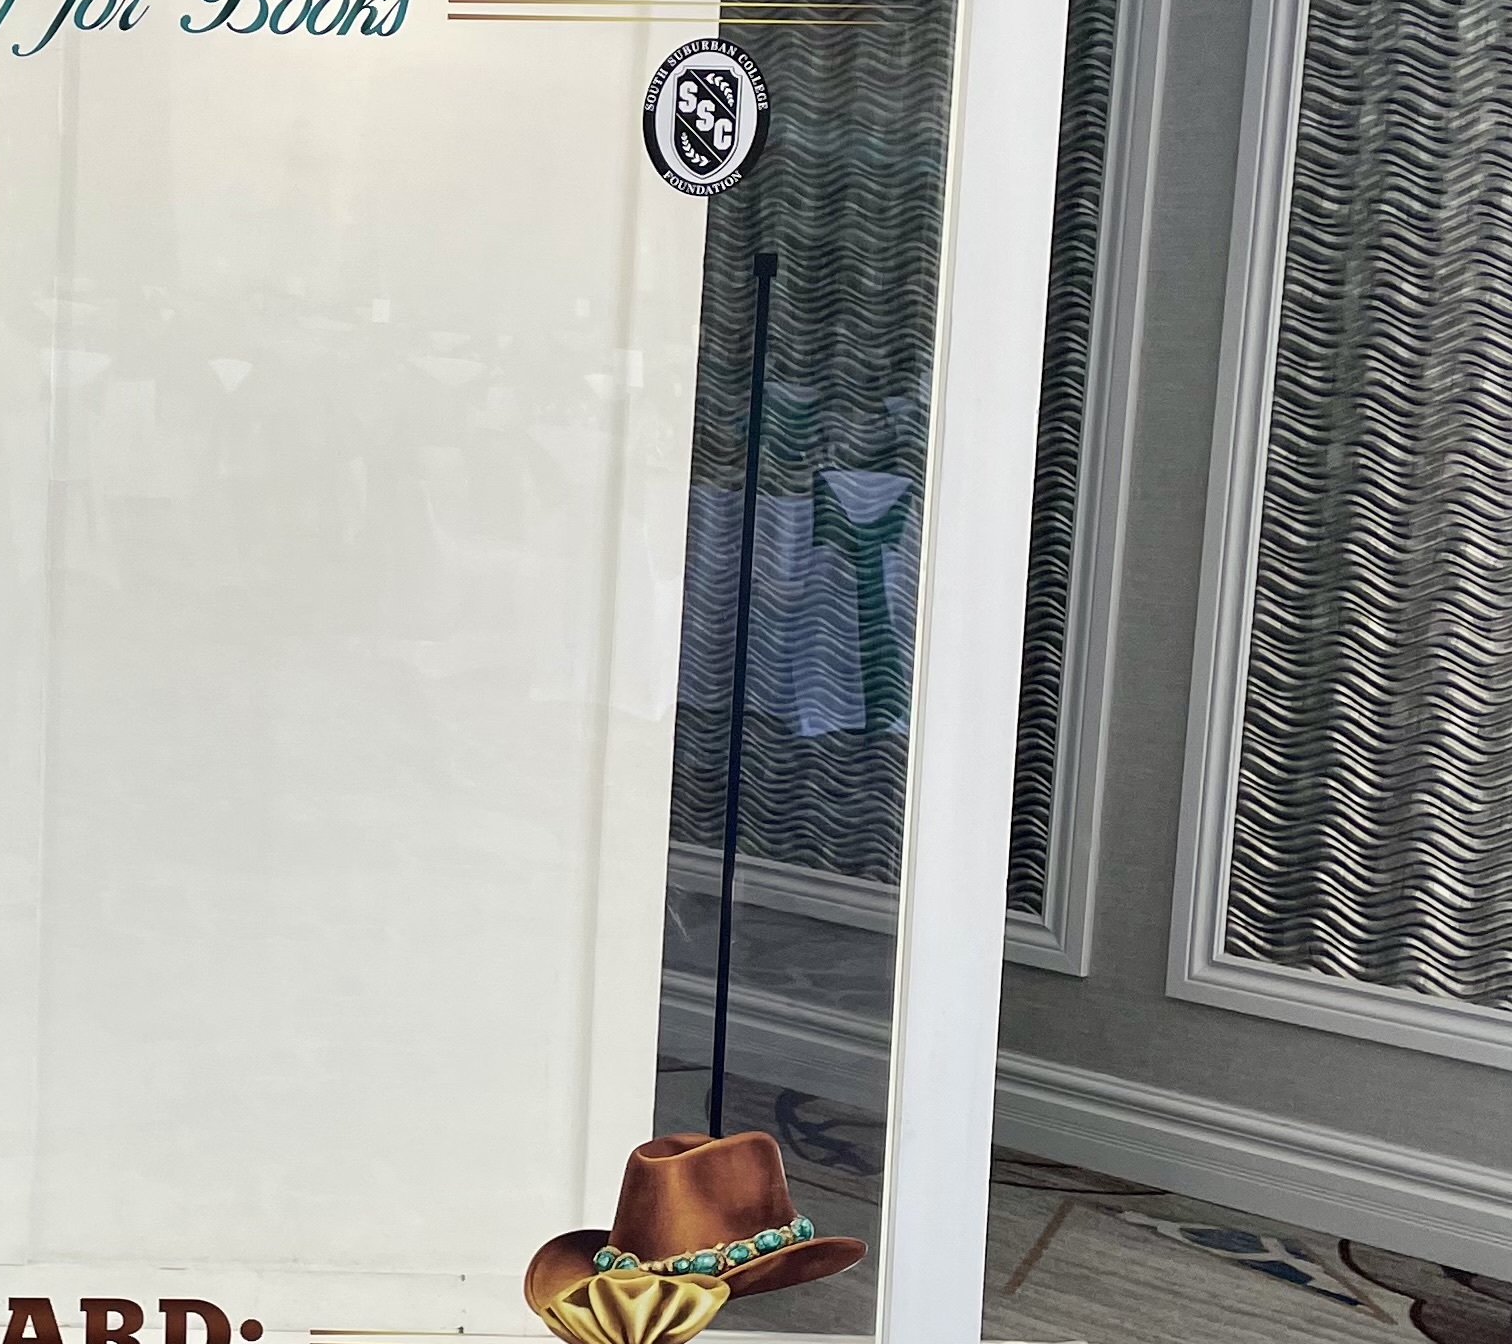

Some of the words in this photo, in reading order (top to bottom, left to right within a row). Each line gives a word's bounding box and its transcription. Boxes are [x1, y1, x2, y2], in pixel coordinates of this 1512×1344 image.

[644, 67, 669, 112] SOUTH
[666, 40, 738, 67] SUBURBAN
[737, 54, 769, 111] COLLEGE
[678, 80, 733, 150] SSC
[662, 169, 743, 196] FOUNDATION
